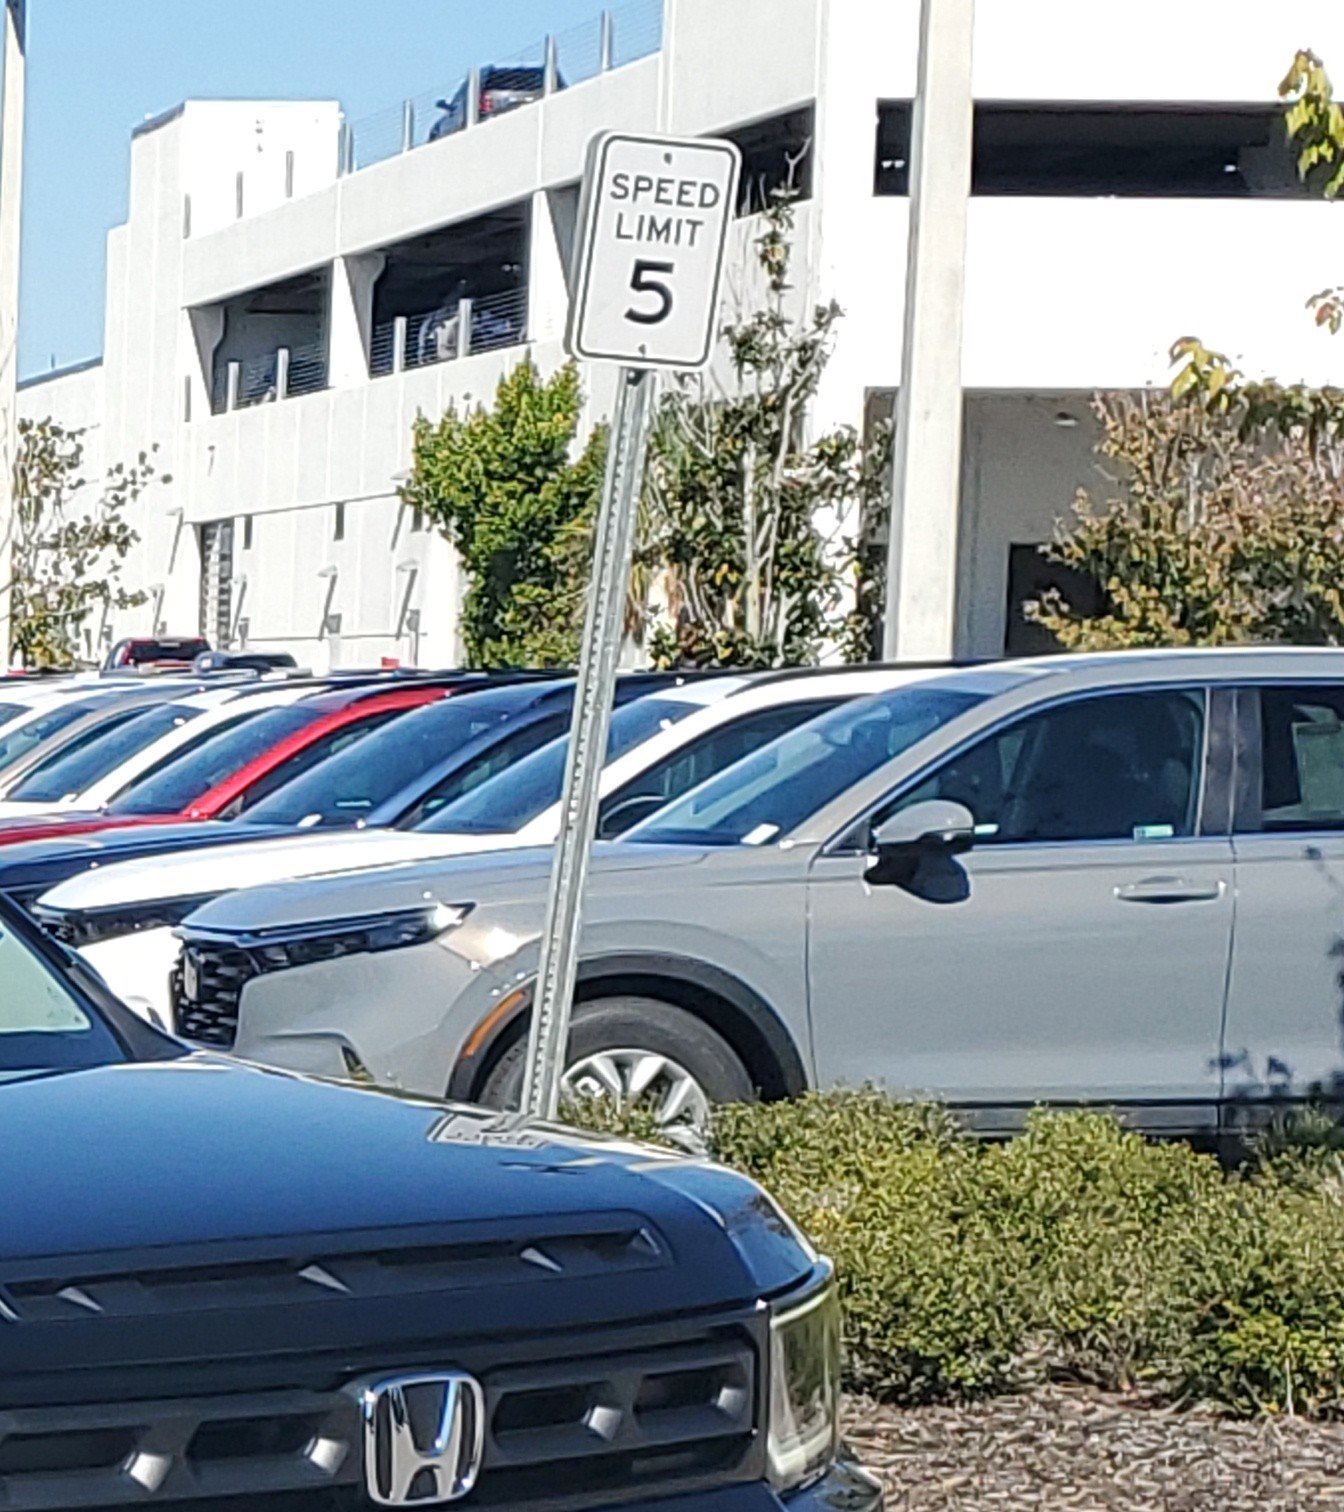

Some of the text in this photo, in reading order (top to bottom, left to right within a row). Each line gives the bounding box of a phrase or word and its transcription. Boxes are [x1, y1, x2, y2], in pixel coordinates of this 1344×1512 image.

[610, 173, 720, 208] SPEED
[615, 213, 704, 246] LIMIT
[624, 259, 675, 325] 5
